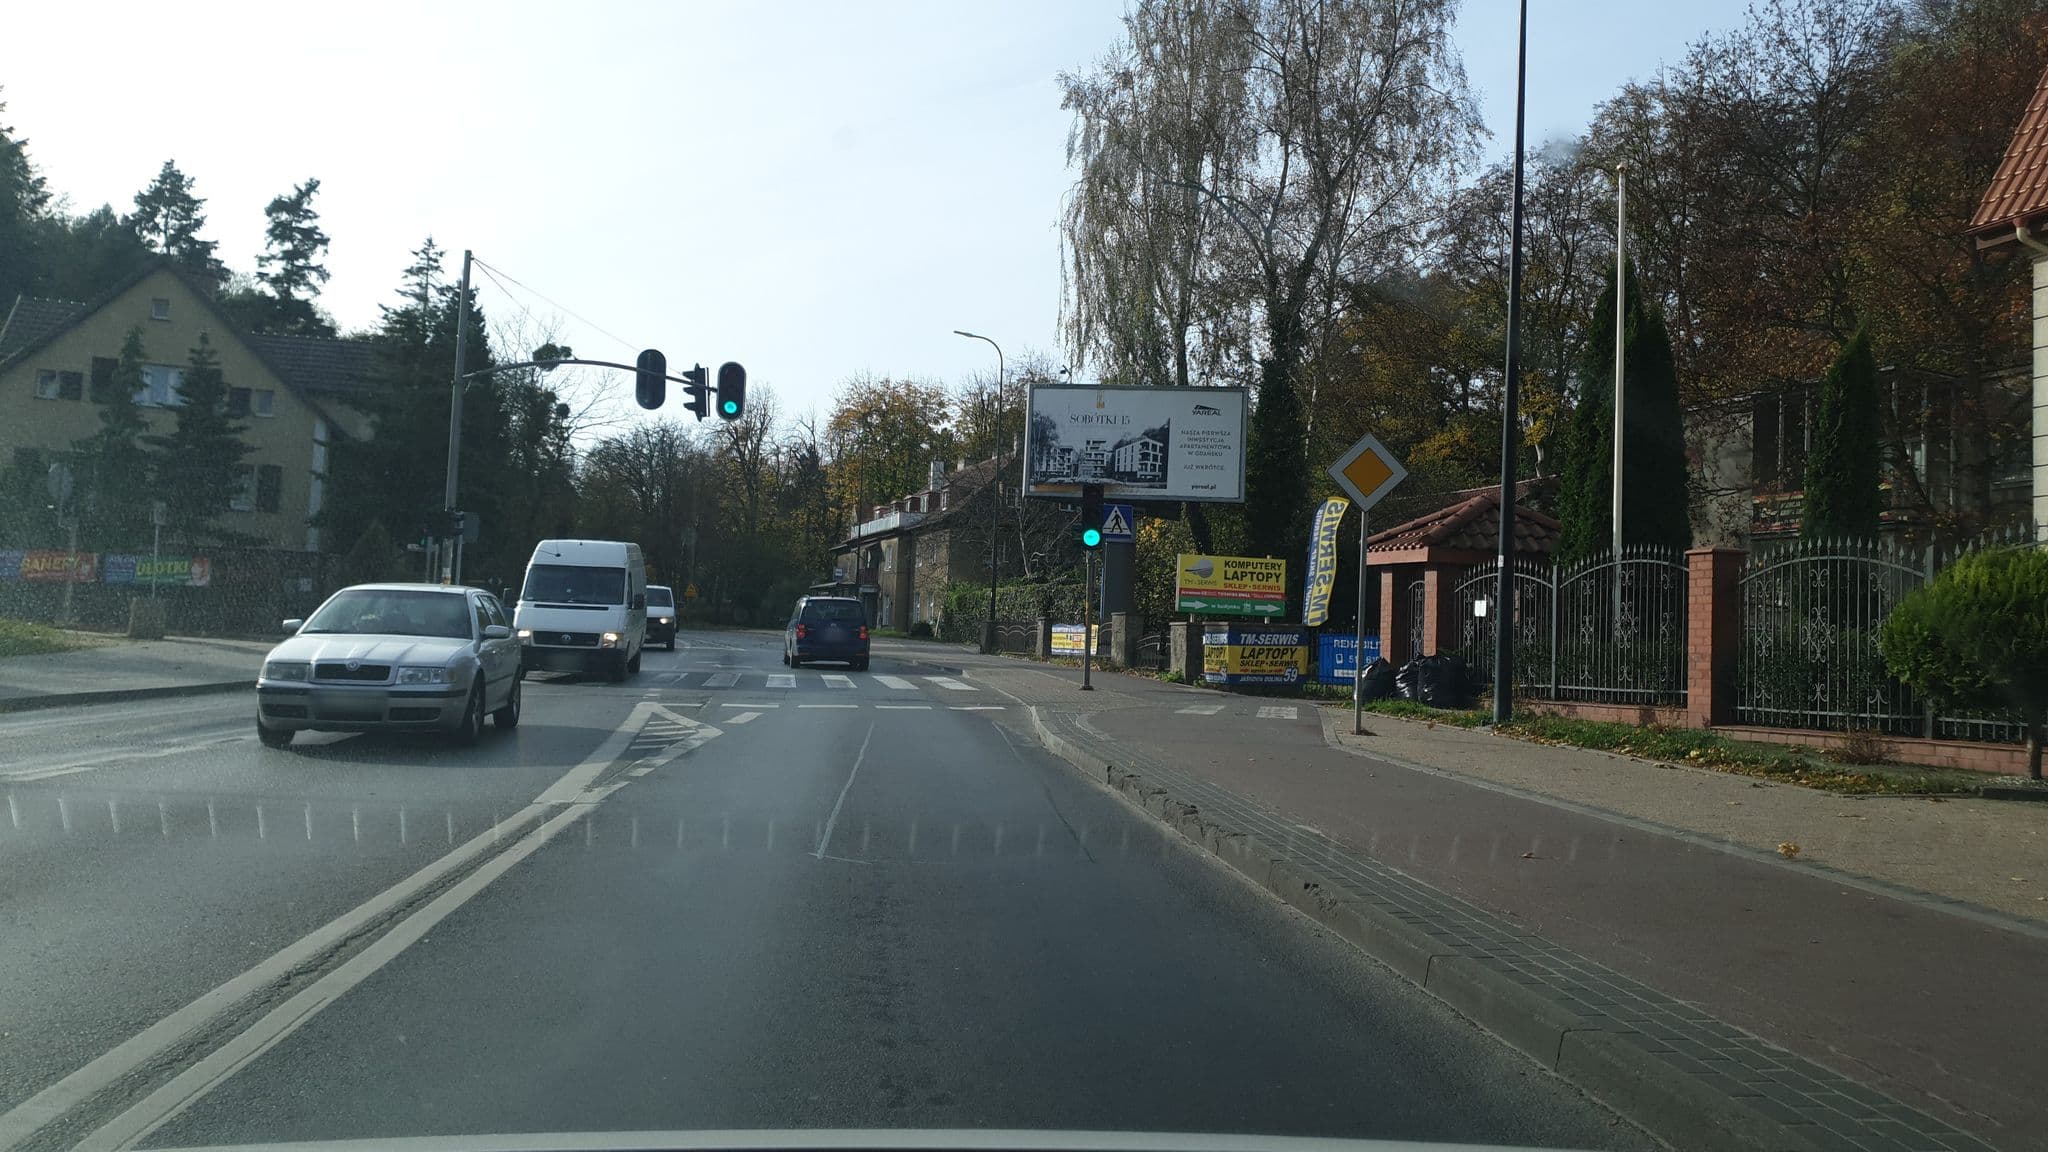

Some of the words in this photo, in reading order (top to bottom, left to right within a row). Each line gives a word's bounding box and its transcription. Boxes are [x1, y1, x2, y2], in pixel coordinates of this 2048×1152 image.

[1070, 412, 1117, 425] SOBÓTKI
[1121, 415, 1131, 425] 15
[1224, 560, 1283, 571] KOMPUTERY
[1224, 570, 1282, 583] LAPTOPY
[1240, 633, 1299, 645] TM-SERWIS
[1240, 647, 1298, 660] LAPTOPY
[1283, 668, 1298, 682] 59
